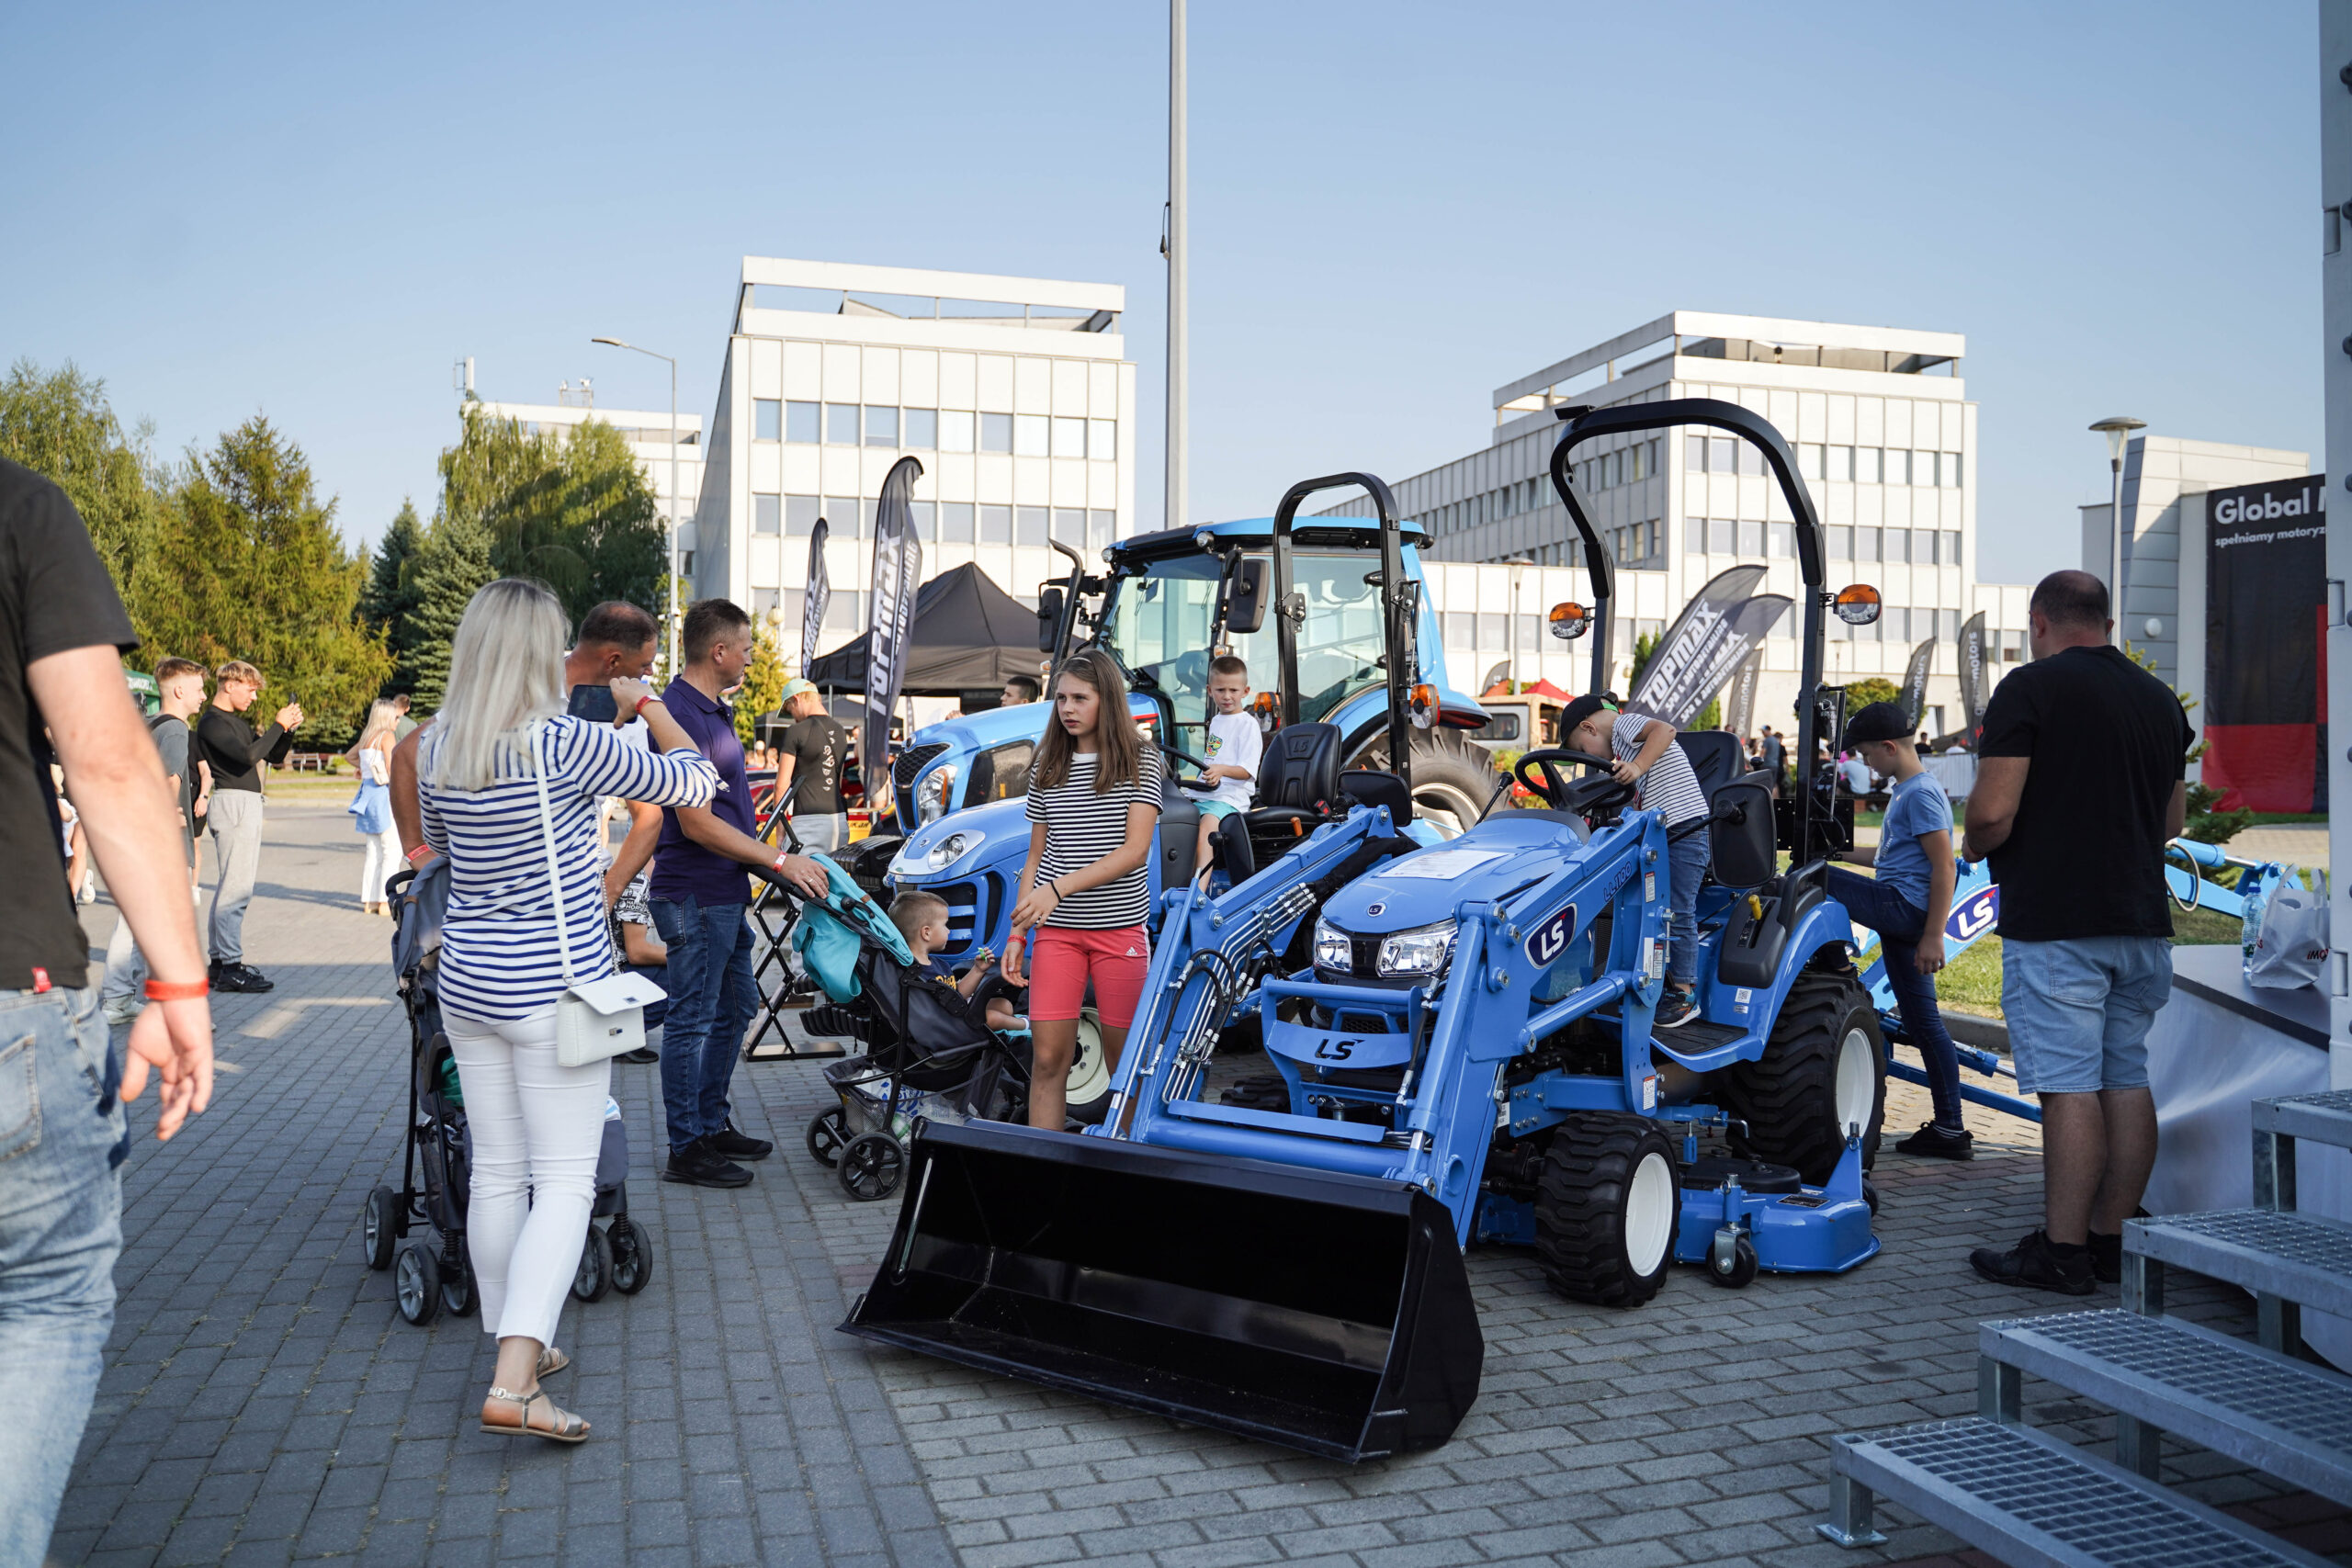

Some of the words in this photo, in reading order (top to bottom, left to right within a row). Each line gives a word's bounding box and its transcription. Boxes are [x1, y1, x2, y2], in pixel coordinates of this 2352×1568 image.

[2215, 487, 2311, 525] Global
[2215, 531, 2274, 548] spełniamy
[1641, 601, 1719, 711] TOPMAX
[1665, 691, 1680, 713] SPA
[1680, 704, 1697, 723] SPA
[1957, 897, 1995, 938] LS
[1541, 919, 1565, 961] LS
[1315, 1039, 1355, 1060] LS
